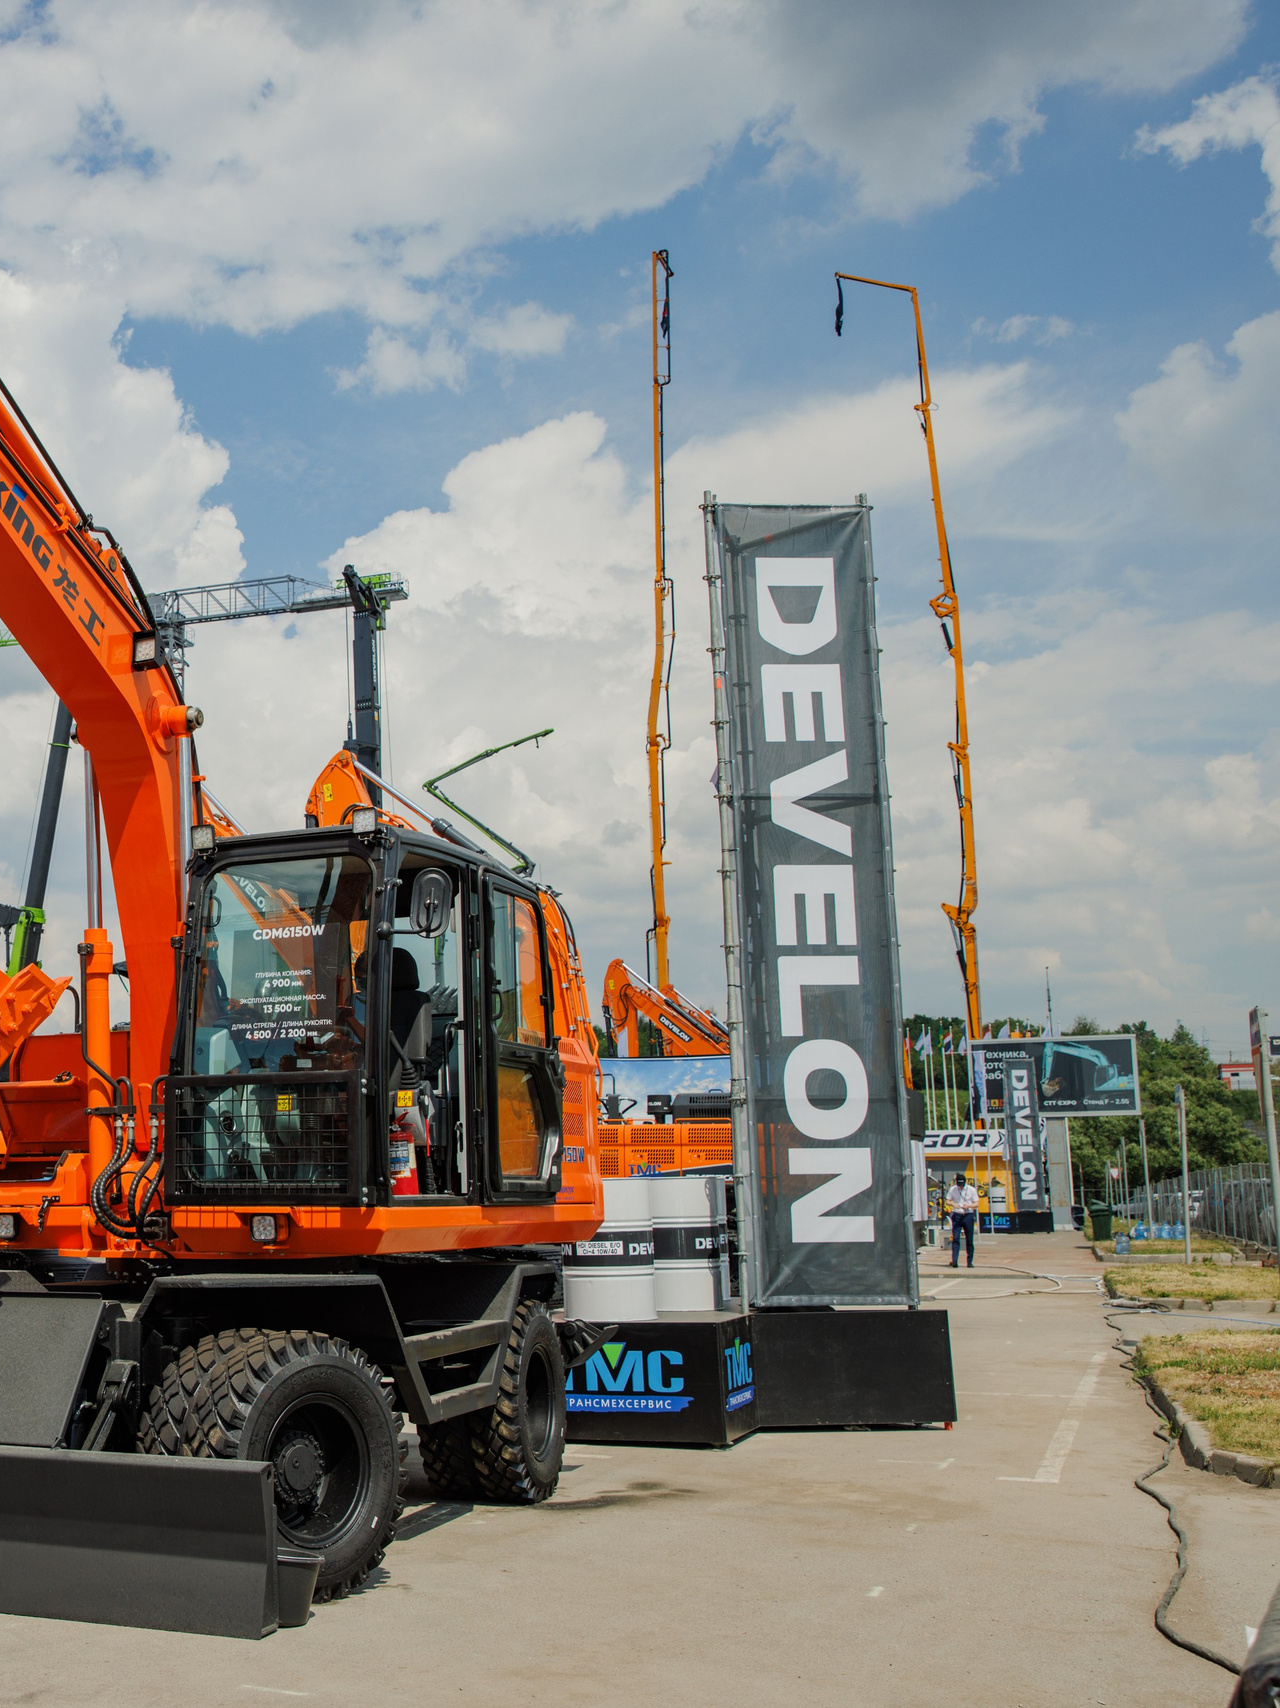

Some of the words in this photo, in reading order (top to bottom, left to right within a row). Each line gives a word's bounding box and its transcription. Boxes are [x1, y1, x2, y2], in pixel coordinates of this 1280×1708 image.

[233, 876, 266, 912] VELO
[755, 557, 875, 1243] DEVELON
[253, 924, 325, 940] CDM6150W
[255, 971, 281, 979] ГЛУБИНА
[265, 979, 270, 987] 4
[272, 978, 290, 987] 900
[263, 1005, 273, 1013] 13
[274, 1004, 292, 1012] 500
[231, 1023, 252, 1031] ДЛИНА
[253, 1021, 277, 1029] СТРЕЛЫ
[282, 1020, 303, 1028] ДЛИНА
[660, 1015, 690, 1042] DEVELON
[245, 1031, 252, 1039] 4
[253, 1030, 271, 1039] 500
[280, 1029, 286, 1038] 2
[288, 1028, 306, 1037] 200
[1011, 1070, 1038, 1200] DEVELON
[561, 1146, 585, 1163] 150W
[567, 1398, 672, 1409] РАНСМЕХСЕРВИС
